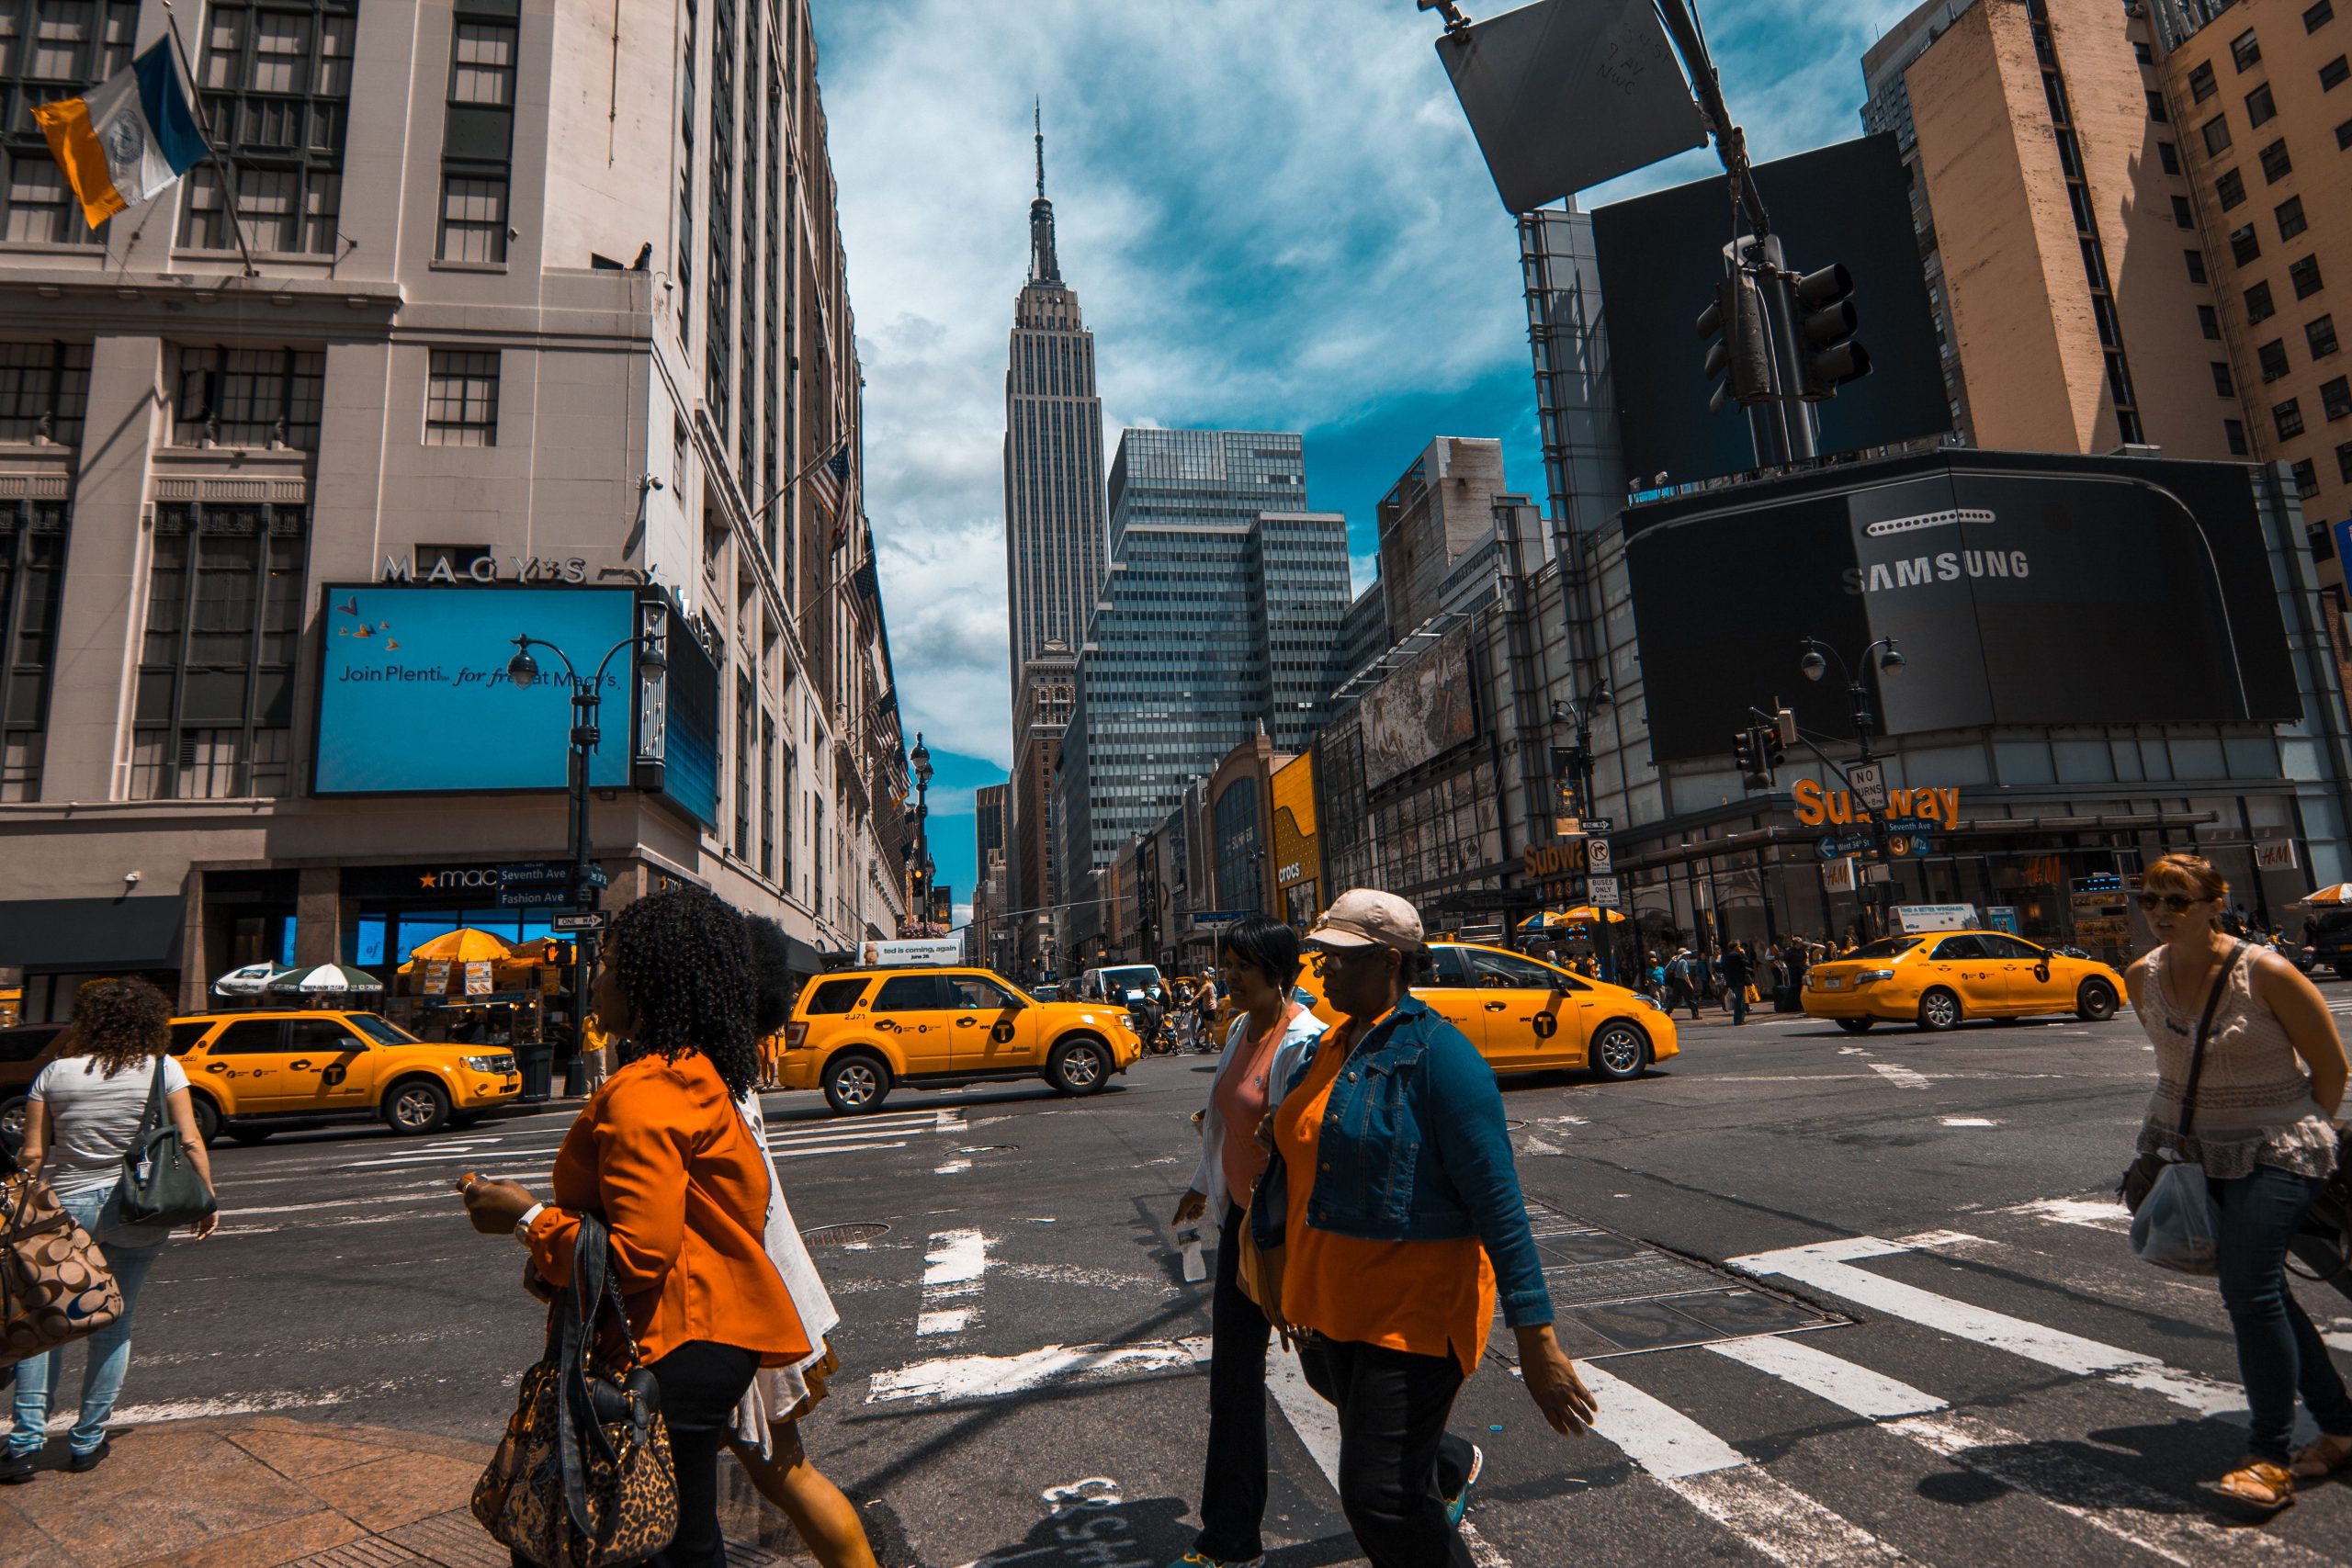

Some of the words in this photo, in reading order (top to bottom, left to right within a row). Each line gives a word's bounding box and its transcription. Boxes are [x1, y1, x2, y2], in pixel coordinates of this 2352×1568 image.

[1841, 550, 2029, 595] SAMSUNG
[338, 665, 381, 682] Join
[386, 665, 441, 682] Plenti
[452, 666, 486, 686] for
[487, 667, 519, 687] fre
[1856, 770, 1873, 784] NO
[1855, 784, 1882, 797] URNS
[1792, 778, 1960, 830] Suway
[1889, 822, 1917, 830] Seventh
[1838, 842, 1851, 852] West
[1862, 839, 1870, 847] St
[1894, 837, 1904, 852] 3
[1524, 838, 1584, 877] Subwa
[2262, 845, 2289, 864] H&M
[440, 869, 504, 890] mac
[502, 868, 543, 880] Seventh
[545, 868, 566, 879] Ave
[1278, 862, 1300, 883] crocs
[1566, 883, 1572, 894] 3
[502, 893, 541, 904] Fashion
[544, 893, 564, 903] Ave
[935, 945, 956, 953] again
[996, 1025, 1010, 1041] T
[1537, 1016, 1552, 1035] T
[328, 1067, 342, 1083] T
